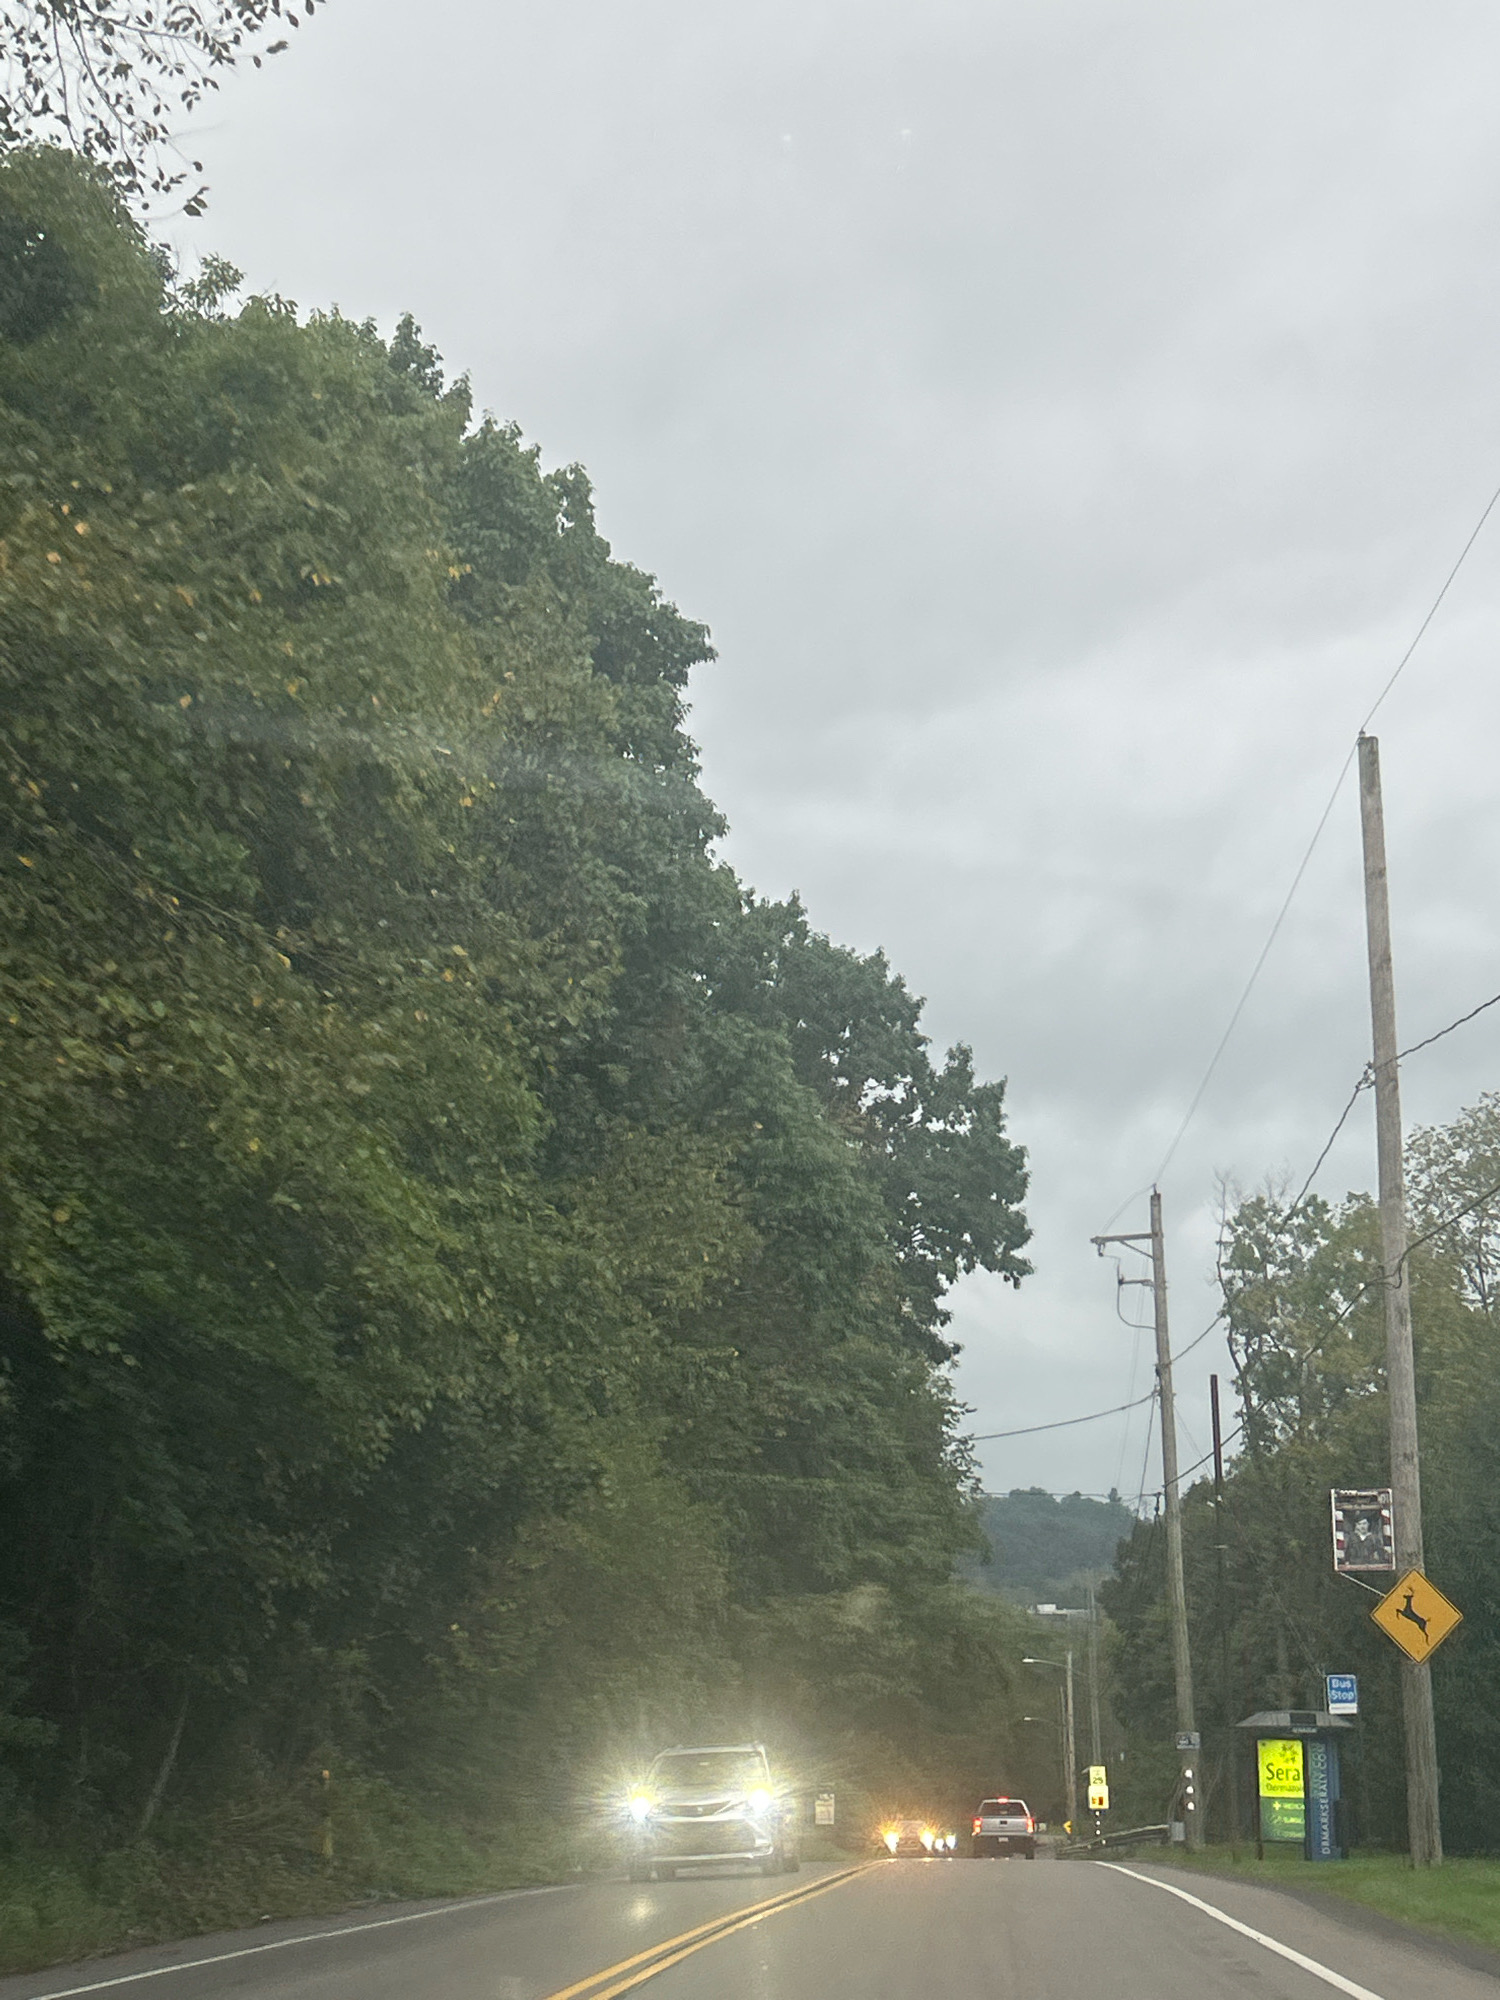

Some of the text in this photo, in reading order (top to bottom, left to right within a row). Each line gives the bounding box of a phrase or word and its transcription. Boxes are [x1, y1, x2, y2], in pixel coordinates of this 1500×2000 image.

[1331, 1678, 1352, 1688] Bus
[1331, 1690, 1355, 1700] Stop
[1266, 1763, 1300, 1781] Sera
